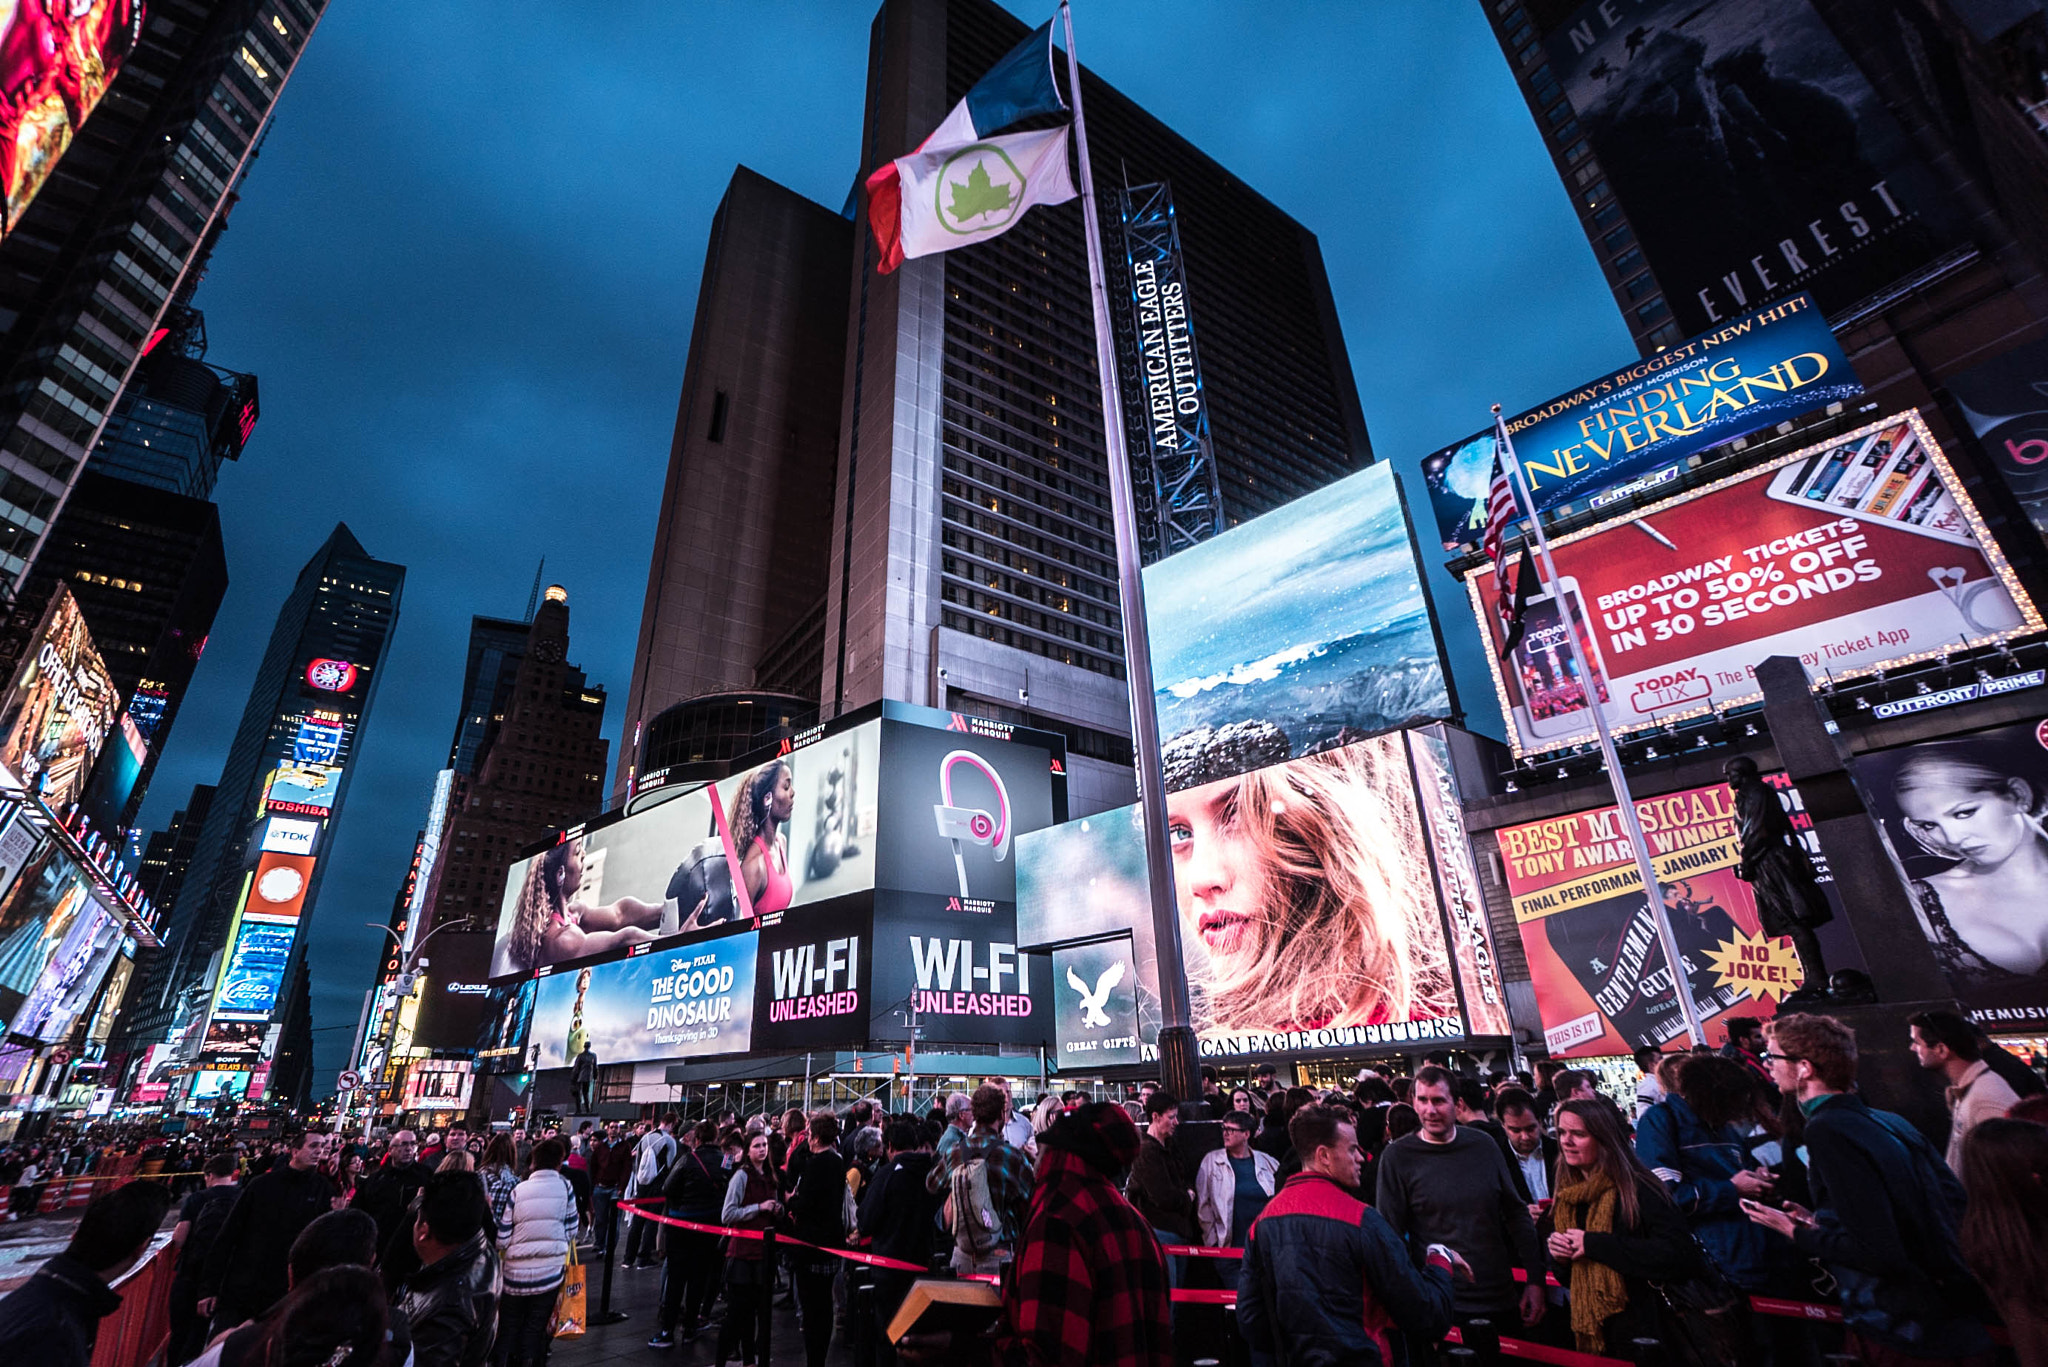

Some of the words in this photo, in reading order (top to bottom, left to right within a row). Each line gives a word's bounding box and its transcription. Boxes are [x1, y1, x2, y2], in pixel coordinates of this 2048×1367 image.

[1697, 180, 1902, 324] EVEREST
[1134, 259, 1162, 322] EAGLE
[1161, 281, 1200, 415] OUTFITTERS
[1505, 380, 1612, 436] BROADWAY'S
[1615, 342, 1697, 387] BIGGEST
[1701, 318, 1752, 350] NEW
[1757, 296, 1810, 326] HIT!
[1142, 328, 1179, 450] AMERICAN
[1577, 356, 1743, 439] FINDING
[1589, 382, 1644, 411] MATTHEW
[1646, 355, 1709, 386] MORRISON
[1523, 351, 1830, 492] NEVERLAND
[1597, 555, 1733, 611] BROADWAY
[1742, 518, 1860, 563] TICKETS
[1602, 603, 1648, 631] UP
[1651, 588, 1700, 616] TO
[1706, 561, 1785, 600] 50%
[1790, 534, 1869, 574] OFF
[1610, 627, 1648, 654] IN
[1651, 613, 1695, 641] 30
[1701, 558, 1883, 626] SECONDS
[1528, 623, 1566, 641] TODAY
[1715, 669, 1744, 687] The
[1821, 635, 1875, 660] Ticket
[1876, 628, 1911, 647] App
[1635, 667, 1698, 694] TODAY
[1652, 683, 1691, 704] TIX
[1878, 687, 1975, 716] OUTFRONT
[1984, 673, 2041, 694] PRIME
[793, 724, 826, 742] MARRIOTT
[793, 733, 822, 750] MARQUIS
[971, 718, 1015, 733] MARRIOTT
[971, 726, 1011, 741] MARQUIS
[267, 800, 329, 816] TOSHIBA
[280, 831, 310, 841] TDK
[1504, 817, 1580, 859] BEST
[1432, 806, 1471, 946] OUTFITTERS
[1511, 852, 1567, 878] TONY
[1574, 840, 1635, 868] AWAR
[1433, 767, 1473, 903] AMERICAN
[1466, 911, 1497, 1005] EAGLE
[1520, 893, 1559, 915] FINAL
[1559, 863, 1660, 903] PERFORMANE
[1662, 845, 1729, 876] JANUARY
[963, 899, 995, 908] MARRIOTT
[384, 945, 401, 984] YOU
[693, 953, 716, 967] PIXAR
[772, 936, 858, 1000] WI-FI
[909, 936, 1029, 995] WI-FI
[1589, 957, 1609, 975] A
[1594, 902, 1658, 1017] GENTLEMAN'
[1740, 944, 1769, 962] NO
[651, 975, 674, 997] THE
[674, 965, 734, 1000] GOOD
[1638, 955, 1698, 998] GUIE
[1725, 963, 1788, 984] JOKE!
[646, 996, 732, 1031] DINOSAUR
[769, 991, 858, 1023] UNLEASHED
[911, 990, 1032, 1017] UNLEASHED
[1970, 1007, 2048, 1021] HEMUSI
[654, 1029, 699, 1046] Thanksgiving
[699, 1028, 707, 1039] in
[708, 1027, 718, 1039] 3D
[1066, 1040, 1098, 1053] GREAT
[1102, 1035, 1136, 1049] GIFTS
[1248, 1029, 1312, 1051] EAGLE
[1317, 1017, 1462, 1046] OUTFITTERS
[1547, 1028, 1570, 1047] THIS
[1571, 1025, 1582, 1039] IS
[1583, 1019, 1597, 1035] IT!
